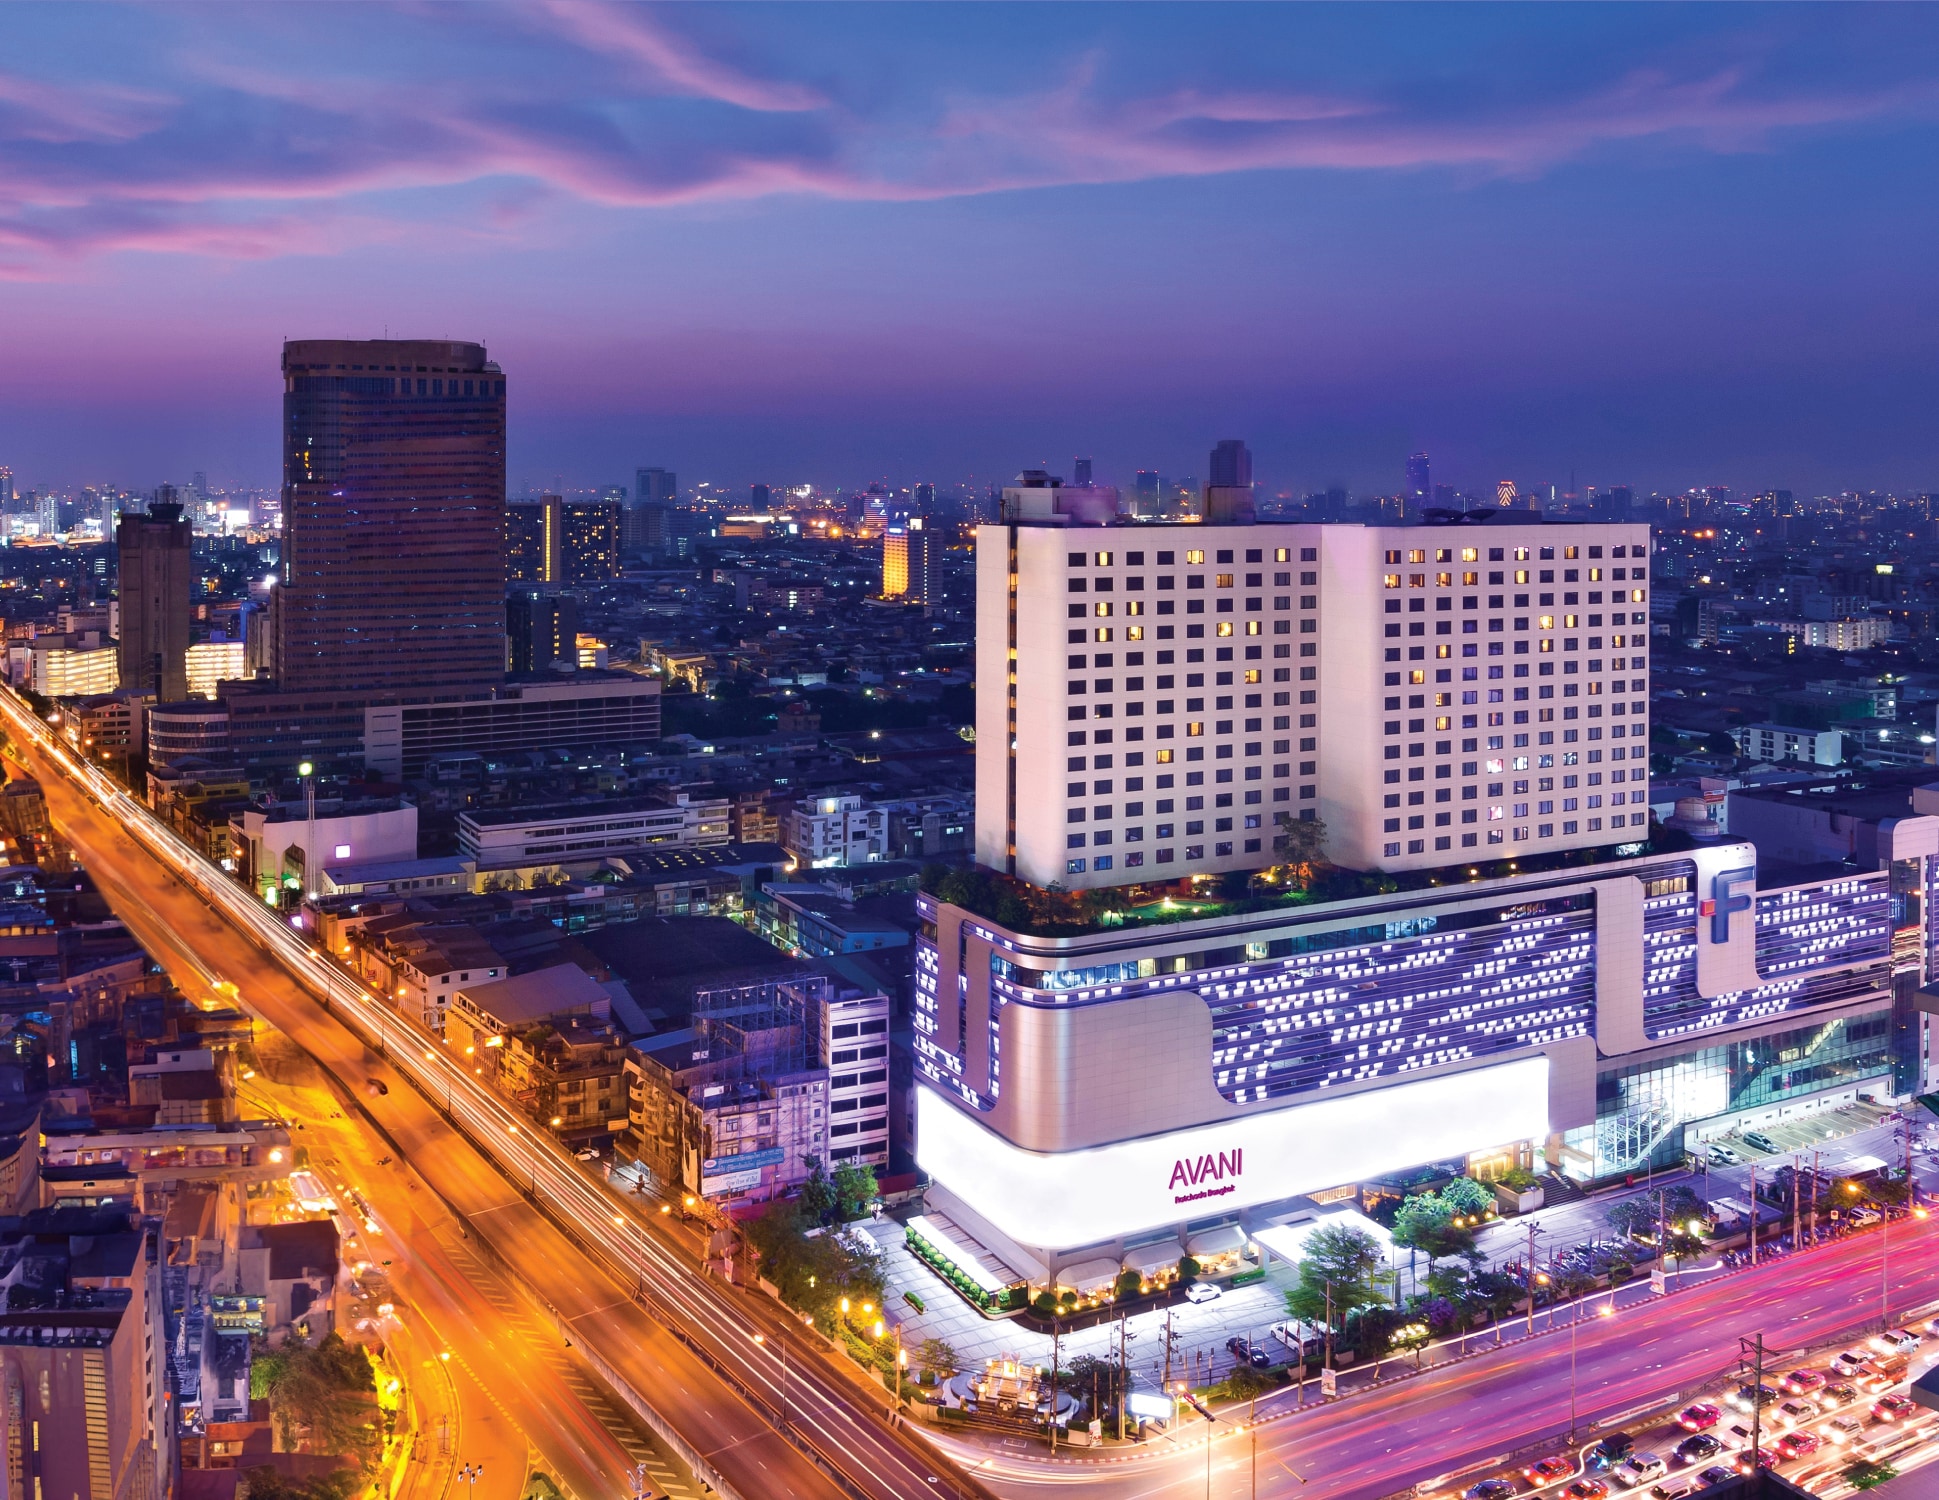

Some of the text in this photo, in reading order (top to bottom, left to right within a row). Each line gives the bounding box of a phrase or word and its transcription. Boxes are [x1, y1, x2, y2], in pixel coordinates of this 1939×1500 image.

[1168, 1148, 1243, 1190] AVANI
[1174, 1184, 1236, 1204] Ratchada Bangkok
